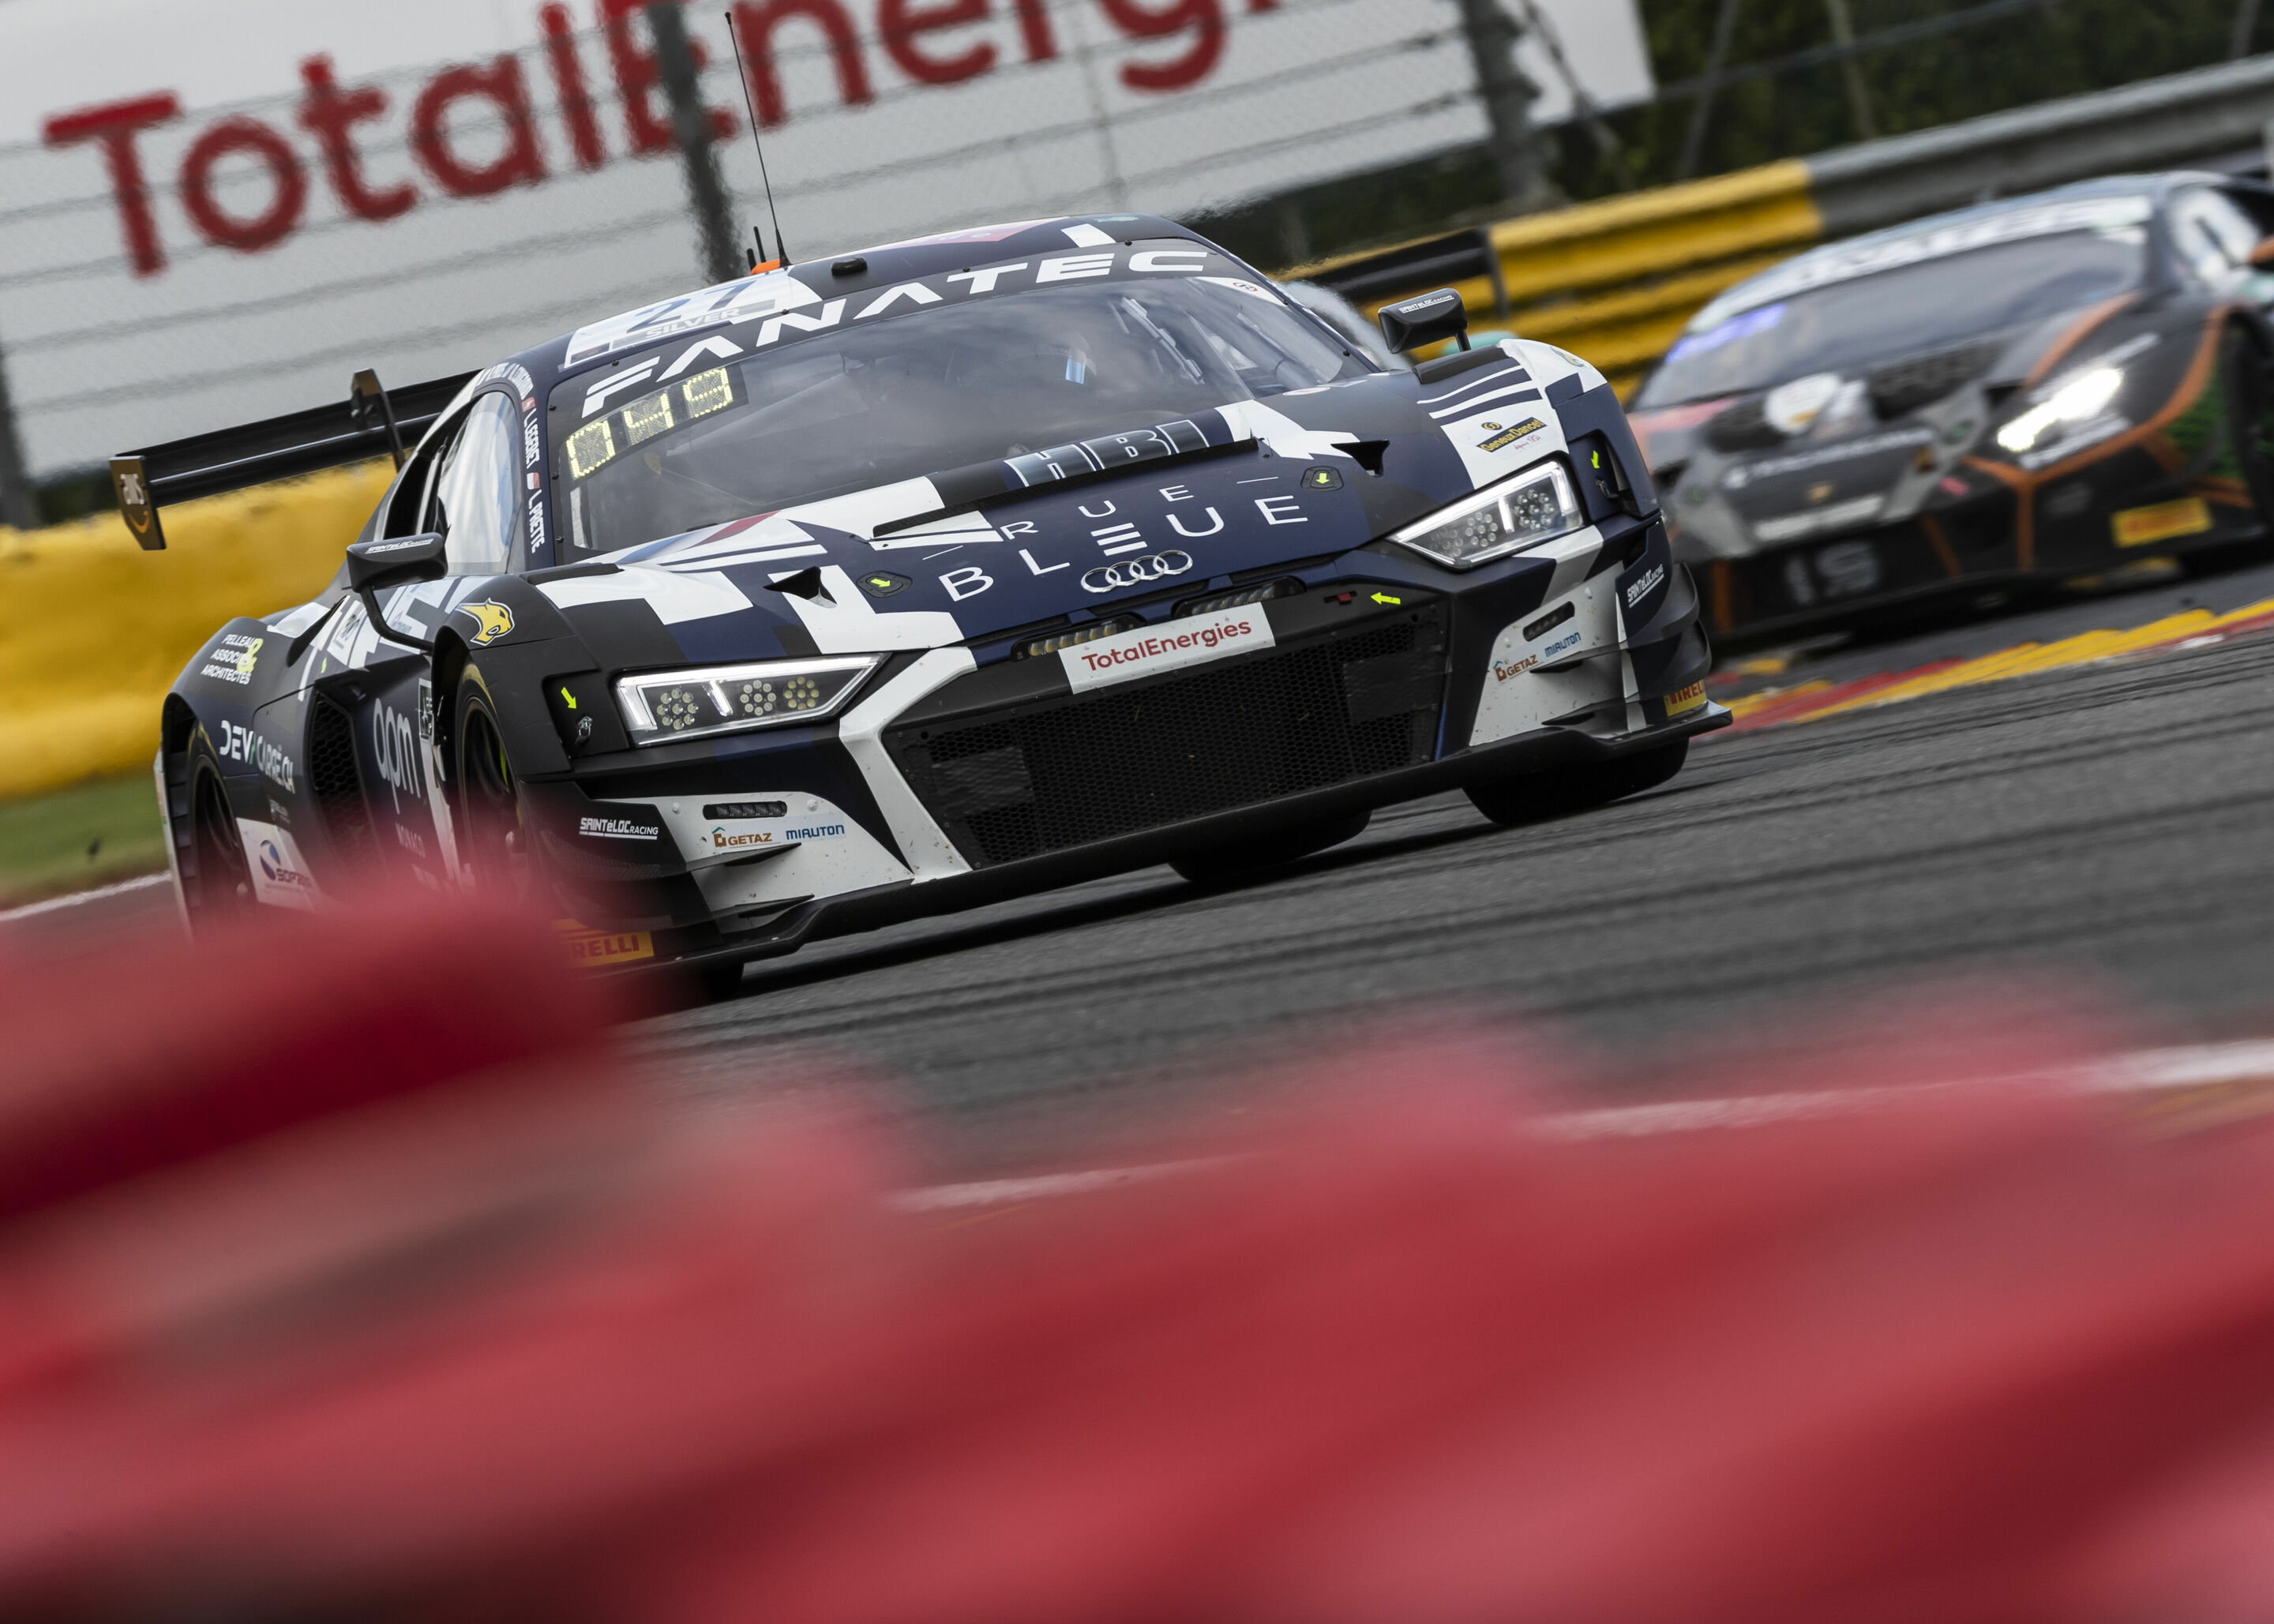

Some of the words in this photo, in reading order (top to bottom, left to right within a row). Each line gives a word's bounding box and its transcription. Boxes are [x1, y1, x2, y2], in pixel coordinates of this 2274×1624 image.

[627, 279, 756, 334] 27
[646, 308, 741, 338] SILVER
[582, 250, 1208, 419] FANATEC
[1004, 419, 1210, 487] HBI
[1000, 485, 1195, 540] RUE
[938, 494, 1308, 602] BLEUE
[1081, 621, 1252, 671] TotalEnergies
[1507, 654, 1538, 677] GETAZ
[1544, 632, 1582, 658] MIAUTON
[201, 664, 252, 685] ARCHITECTES
[629, 825, 659, 836] RACING
[728, 833, 773, 846] GETAZ
[786, 824, 845, 840] MIAUTON
